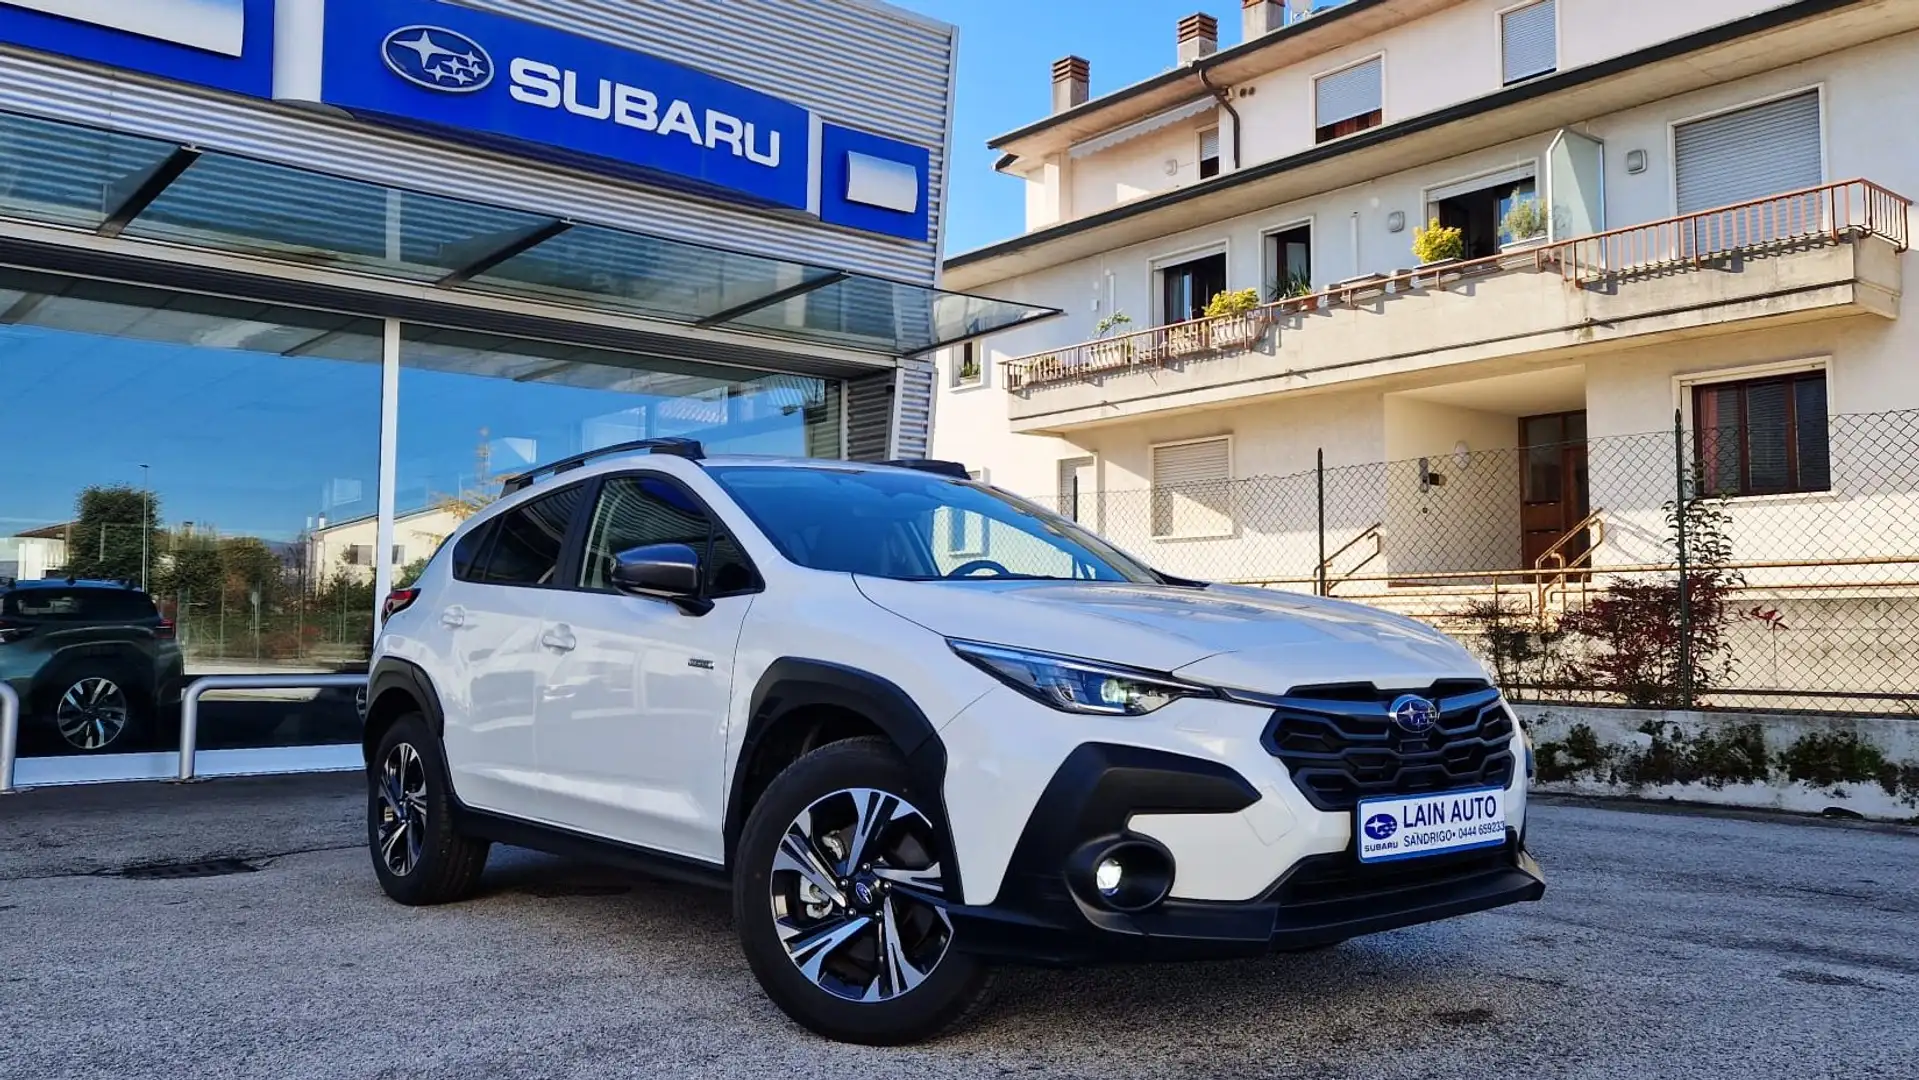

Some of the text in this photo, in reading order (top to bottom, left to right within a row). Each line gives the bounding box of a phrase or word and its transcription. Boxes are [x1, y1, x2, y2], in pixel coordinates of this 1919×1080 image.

[509, 57, 780, 168] SUBARU
[1403, 795, 1497, 828] LAIN AUTO
[1458, 825, 1477, 839] 0444
[1364, 841, 1399, 852] SUBARU
